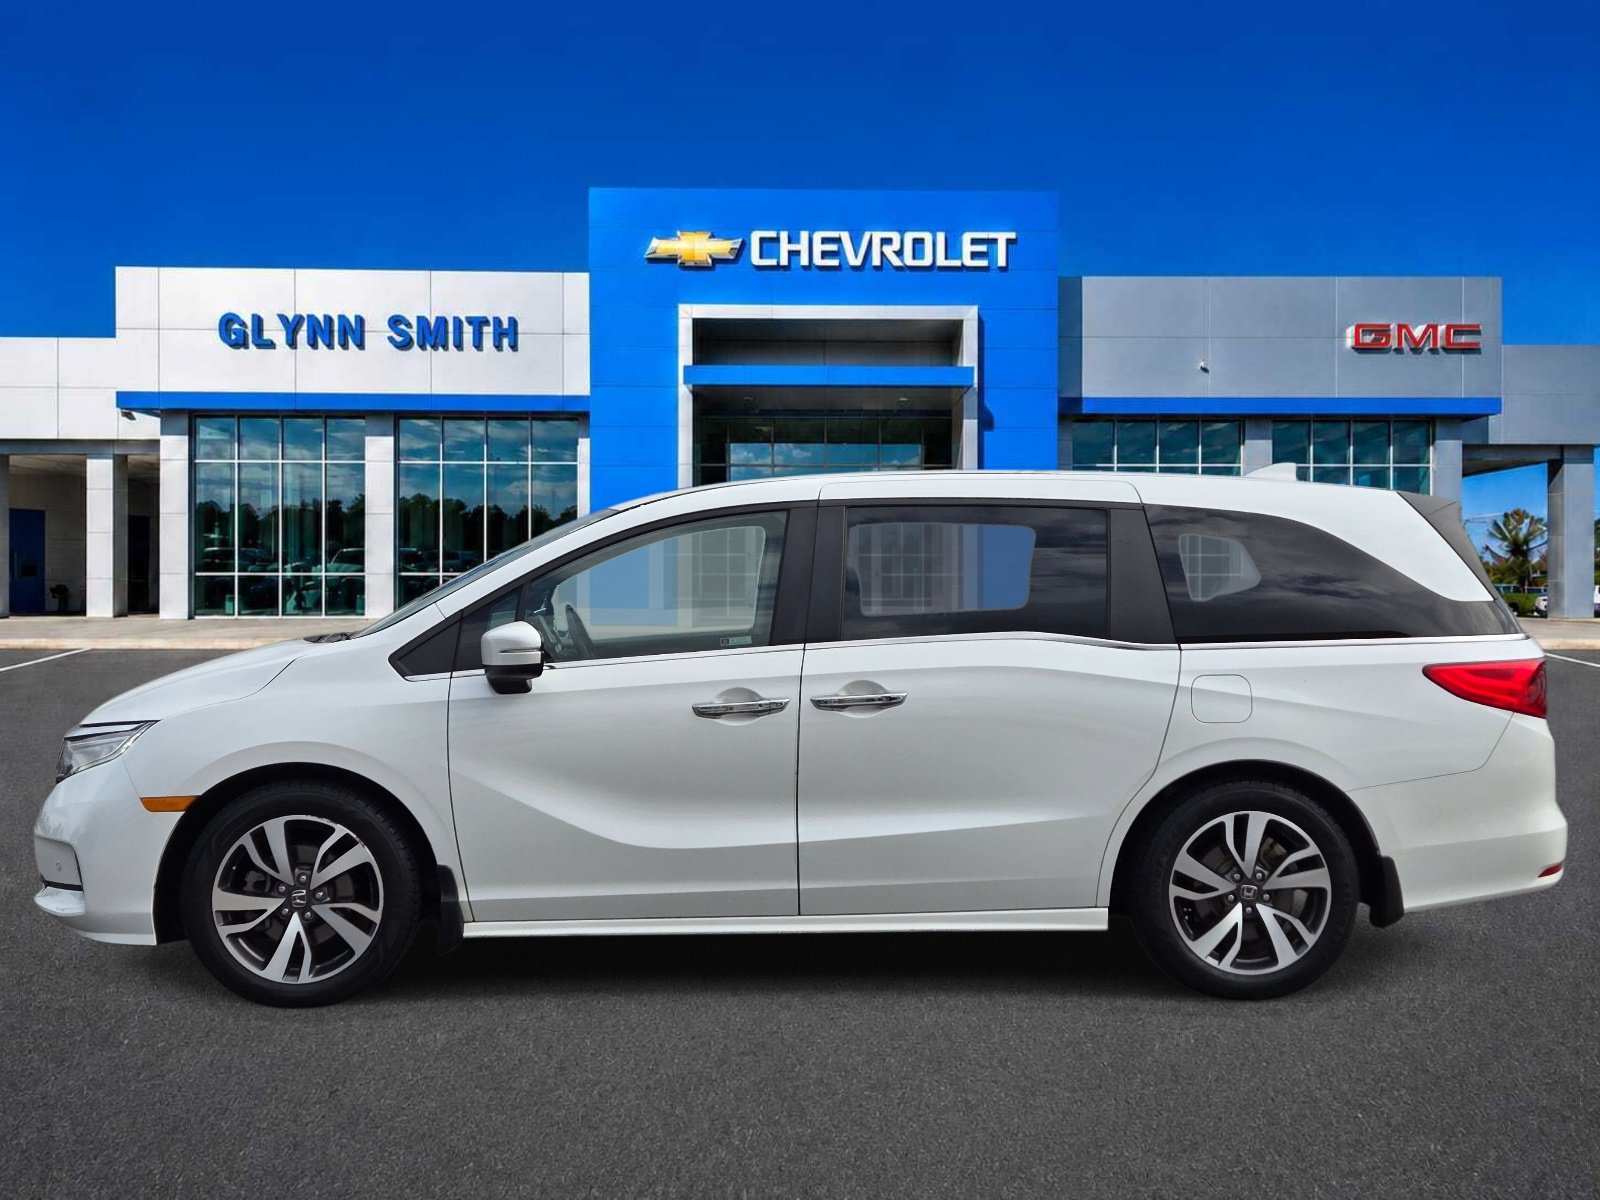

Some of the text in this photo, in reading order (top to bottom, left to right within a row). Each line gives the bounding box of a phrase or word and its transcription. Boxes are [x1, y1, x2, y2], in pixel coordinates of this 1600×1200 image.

[751, 230, 1017, 269] CHEVROLET
[218, 311, 519, 352] GLYNN SMITH
[1349, 322, 1482, 353] GMC
